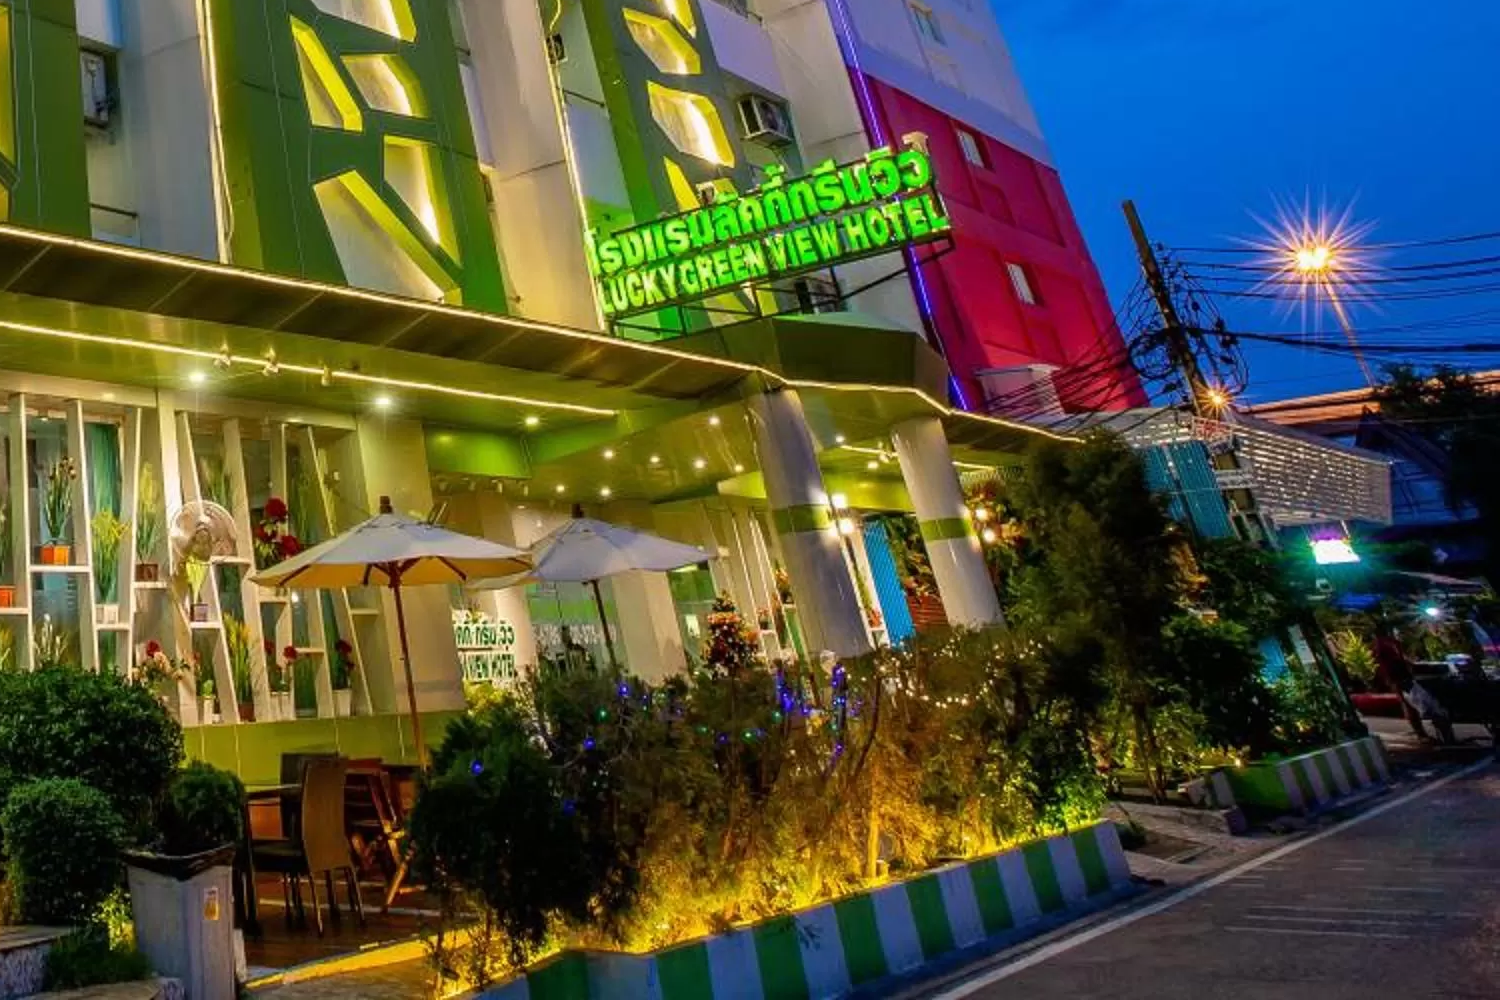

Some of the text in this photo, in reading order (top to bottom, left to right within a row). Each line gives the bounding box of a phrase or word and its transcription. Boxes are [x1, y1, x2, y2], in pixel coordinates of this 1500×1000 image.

[597, 194, 951, 314] LUCKY GREEN VIEW HOTEL
